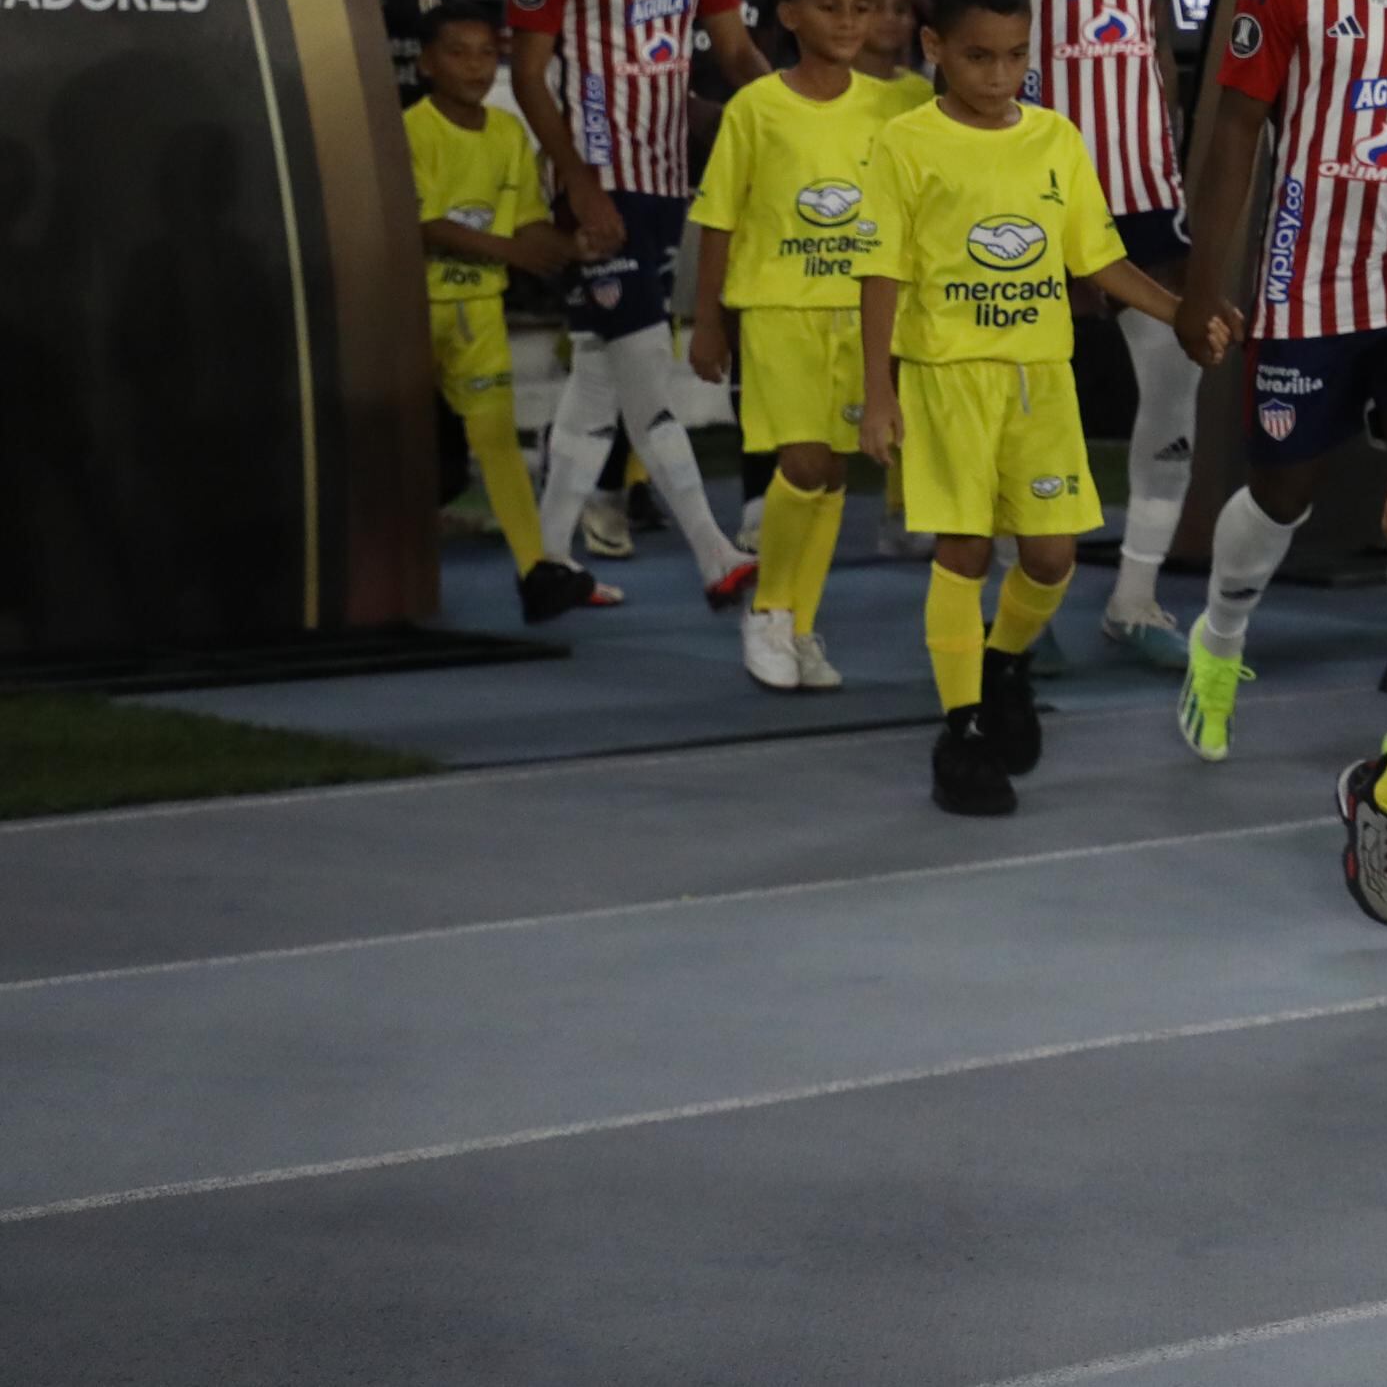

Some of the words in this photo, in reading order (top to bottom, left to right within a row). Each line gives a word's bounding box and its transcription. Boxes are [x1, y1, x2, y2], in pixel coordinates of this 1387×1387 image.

[781, 235, 858, 256] merca
[804, 256, 852, 277] libre
[976, 303, 1038, 328] libre
